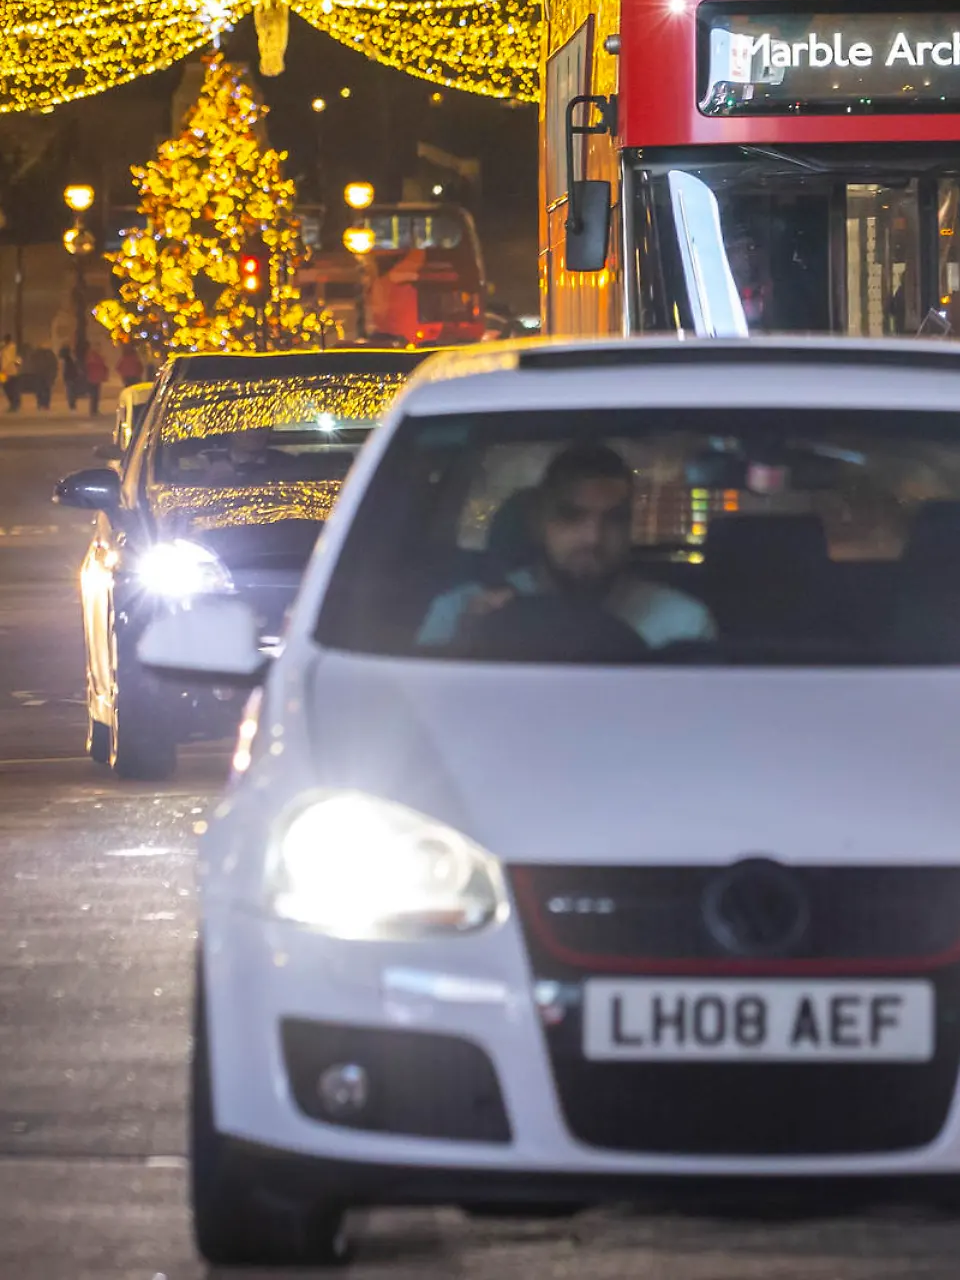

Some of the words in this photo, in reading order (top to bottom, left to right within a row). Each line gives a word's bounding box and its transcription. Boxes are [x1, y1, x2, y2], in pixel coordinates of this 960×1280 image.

[737, 32, 873, 68] Marble
[609, 994, 769, 1048] LH08
[790, 994, 905, 1048] AEF
